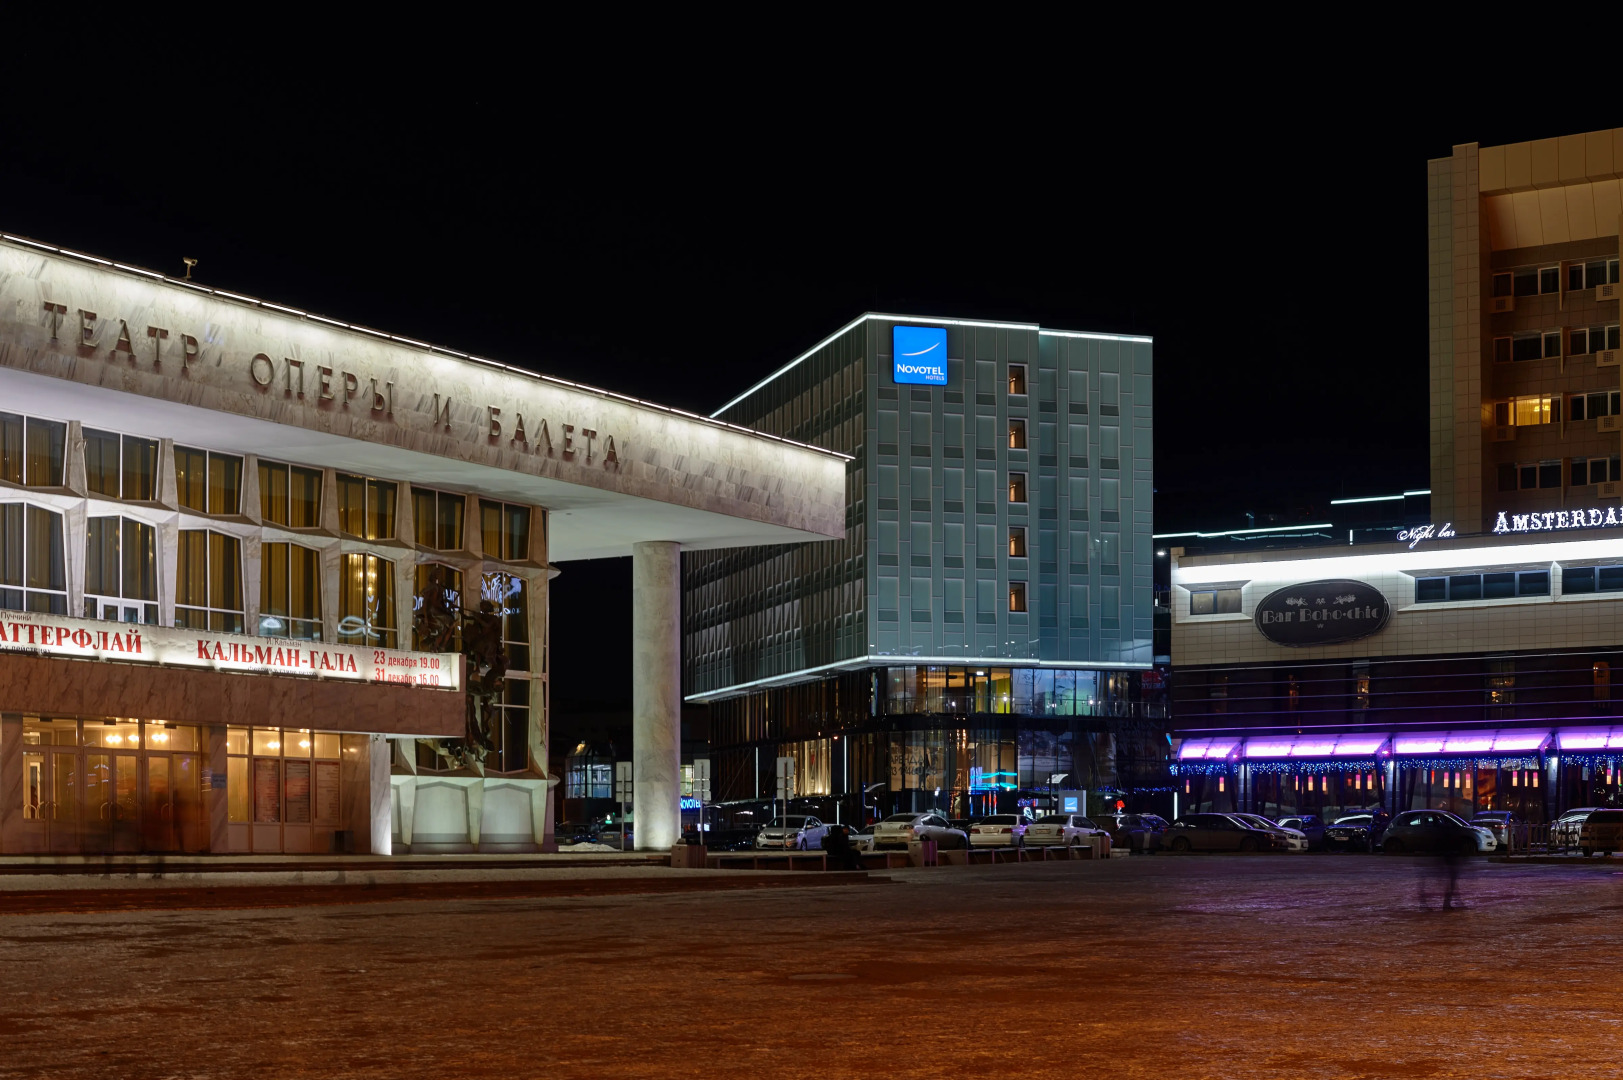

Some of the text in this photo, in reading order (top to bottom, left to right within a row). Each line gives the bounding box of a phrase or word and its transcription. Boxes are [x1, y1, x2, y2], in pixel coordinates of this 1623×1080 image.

[896, 363, 944, 375] NOVOTEL
[44, 301, 619, 465] ТЕАТР ОПЕРЫ И БАЛЕТА
[1492, 505, 1623, 534] AMSTERDA
[1396, 522, 1456, 549] Night bar
[0, 611, 32, 623] Пуччини
[1262, 609, 1295, 625] Bar
[274, 638, 302, 648] Кальман
[196, 639, 358, 673] КАЛЬМАН-ГАЛА
[373, 650, 440, 670] 23 декабря 19.00
[375, 667, 440, 686] 31 декабря 16.00
